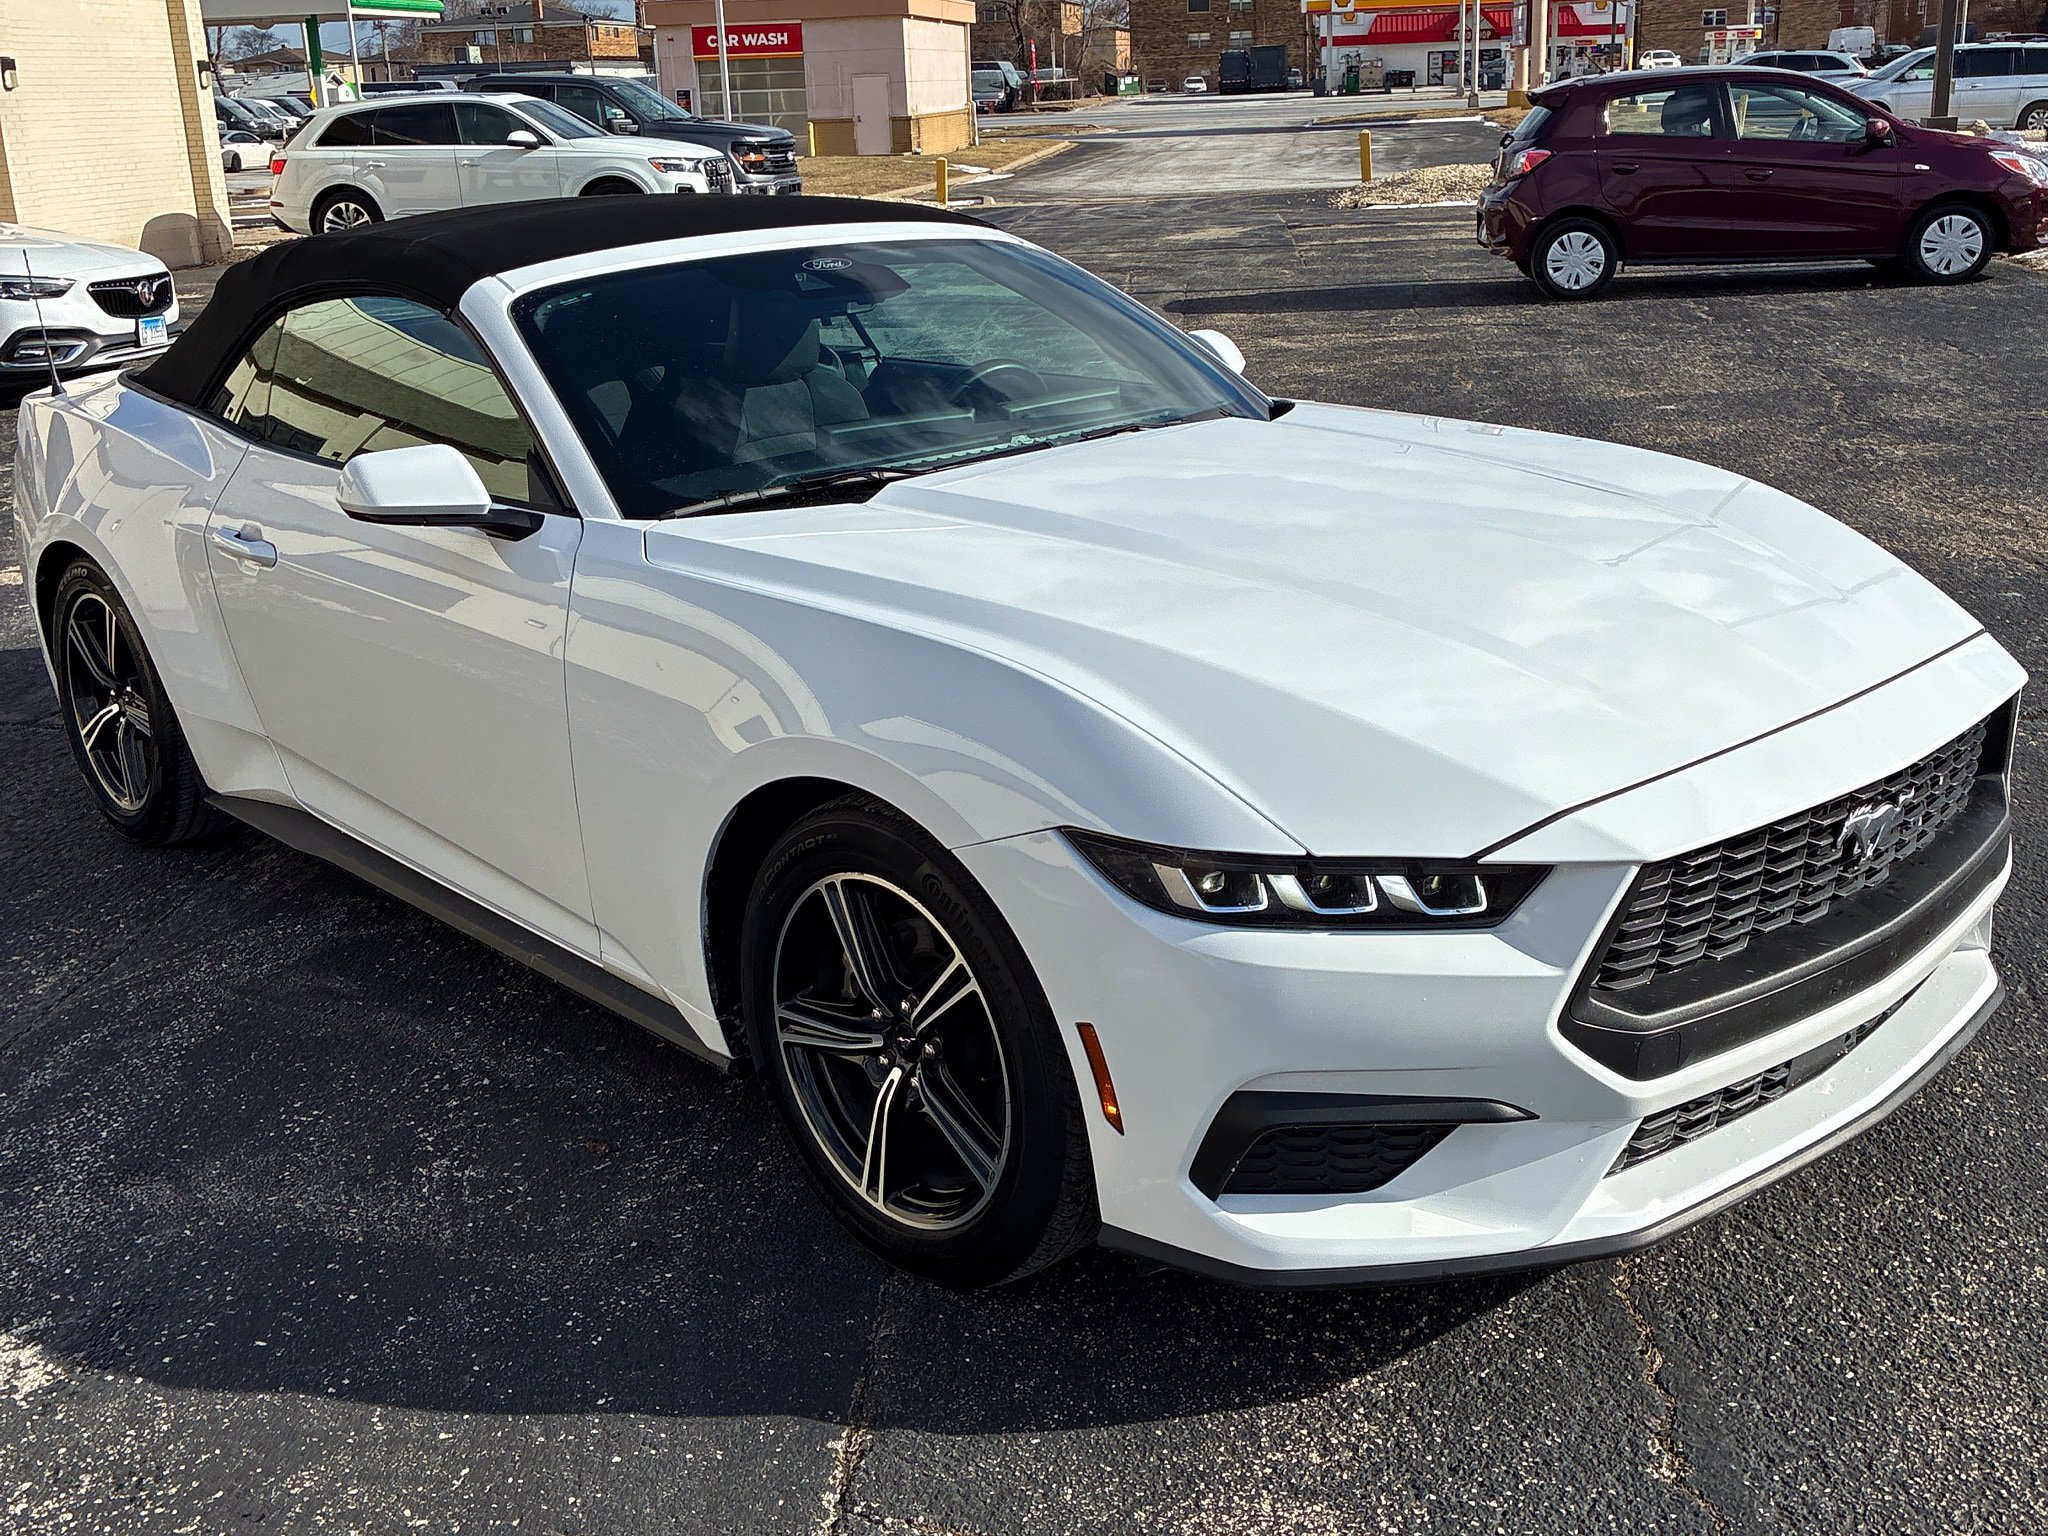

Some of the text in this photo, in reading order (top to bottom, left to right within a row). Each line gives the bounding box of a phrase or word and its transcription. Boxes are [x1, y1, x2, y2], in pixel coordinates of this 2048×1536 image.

[707, 32, 788, 47] CR WASH
[1453, 31, 1471, 39] FD
[812, 260, 844, 269] Ford
